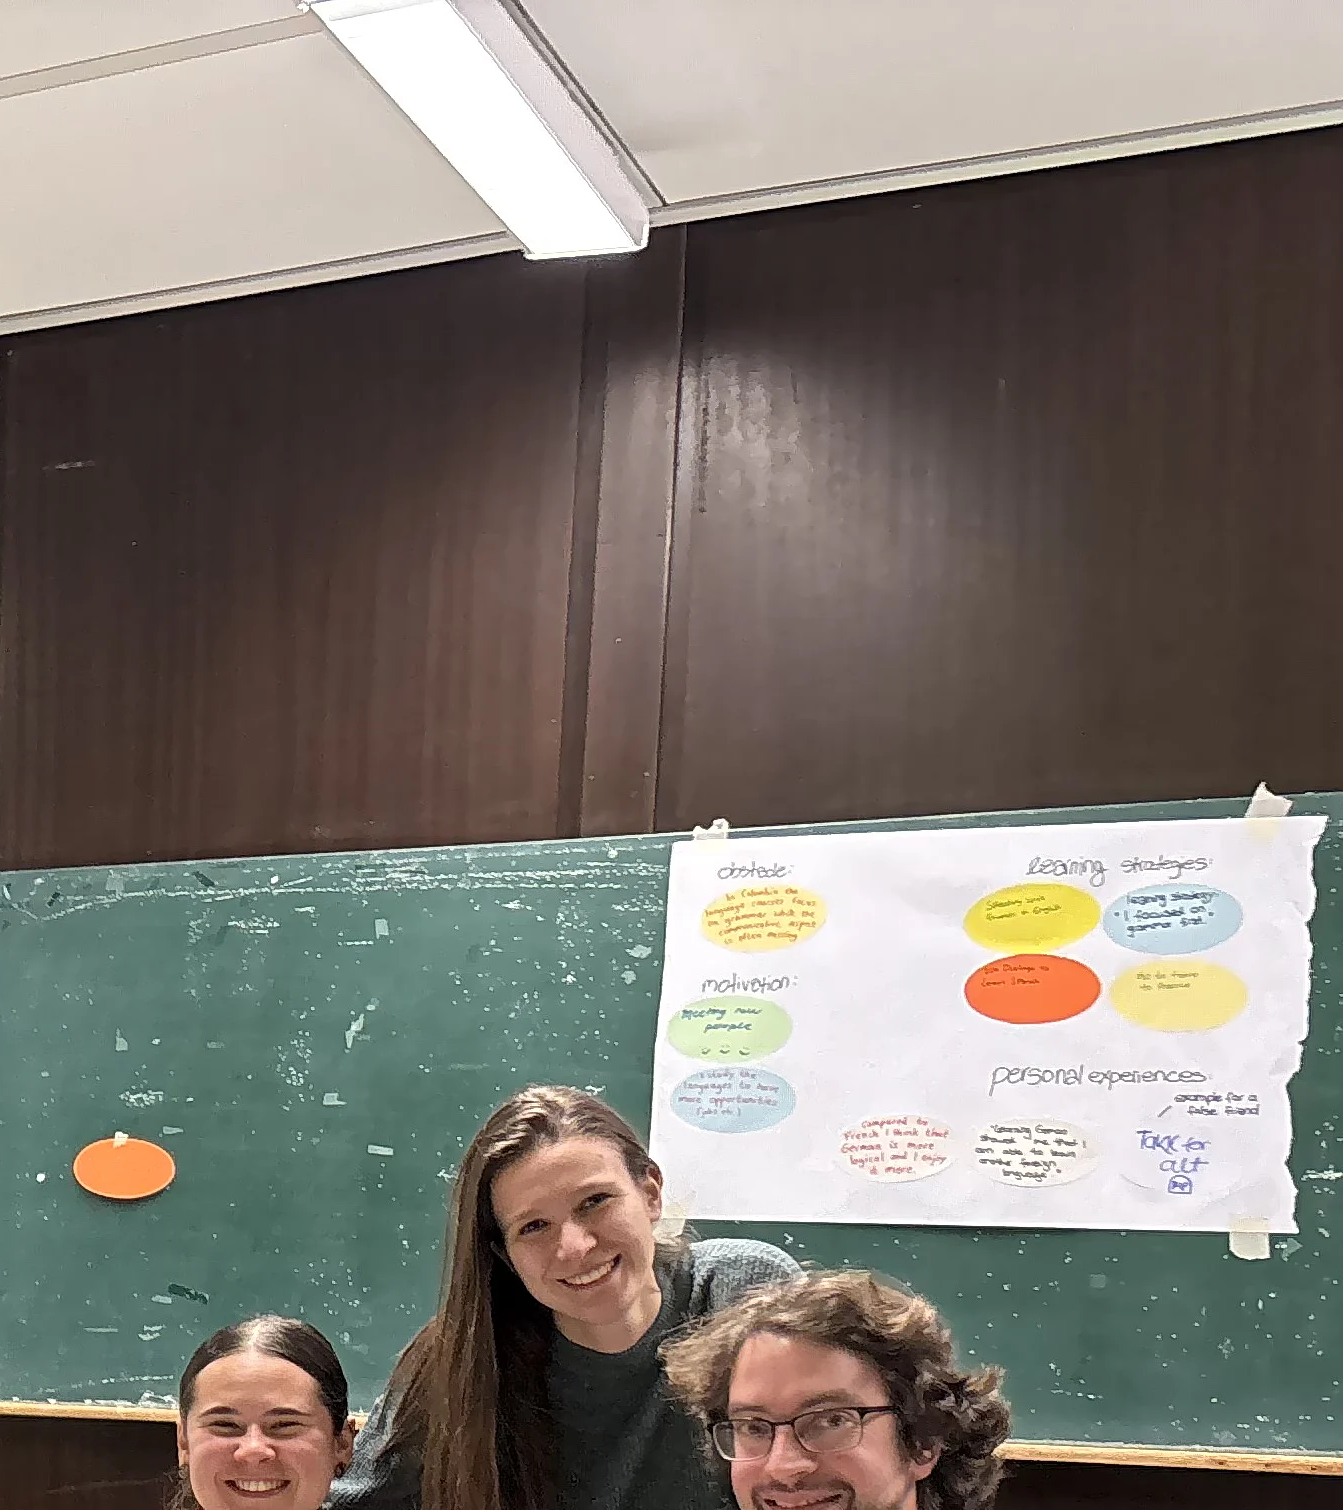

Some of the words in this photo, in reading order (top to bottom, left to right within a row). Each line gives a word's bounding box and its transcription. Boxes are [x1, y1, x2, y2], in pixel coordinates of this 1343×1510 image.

[1025, 856, 1109, 887] learning
[681, 1007, 727, 1020] Meeting
[707, 1070, 735, 1080] study
[989, 1064, 1084, 1096] personal
[739, 1081, 751, 1089] to
[1225, 1092, 1245, 1103] for
[1248, 1094, 1257, 1102] a
[843, 1129, 879, 1140] French
[893, 1127, 919, 1136] think
[1181, 1137, 1211, 1152] for
